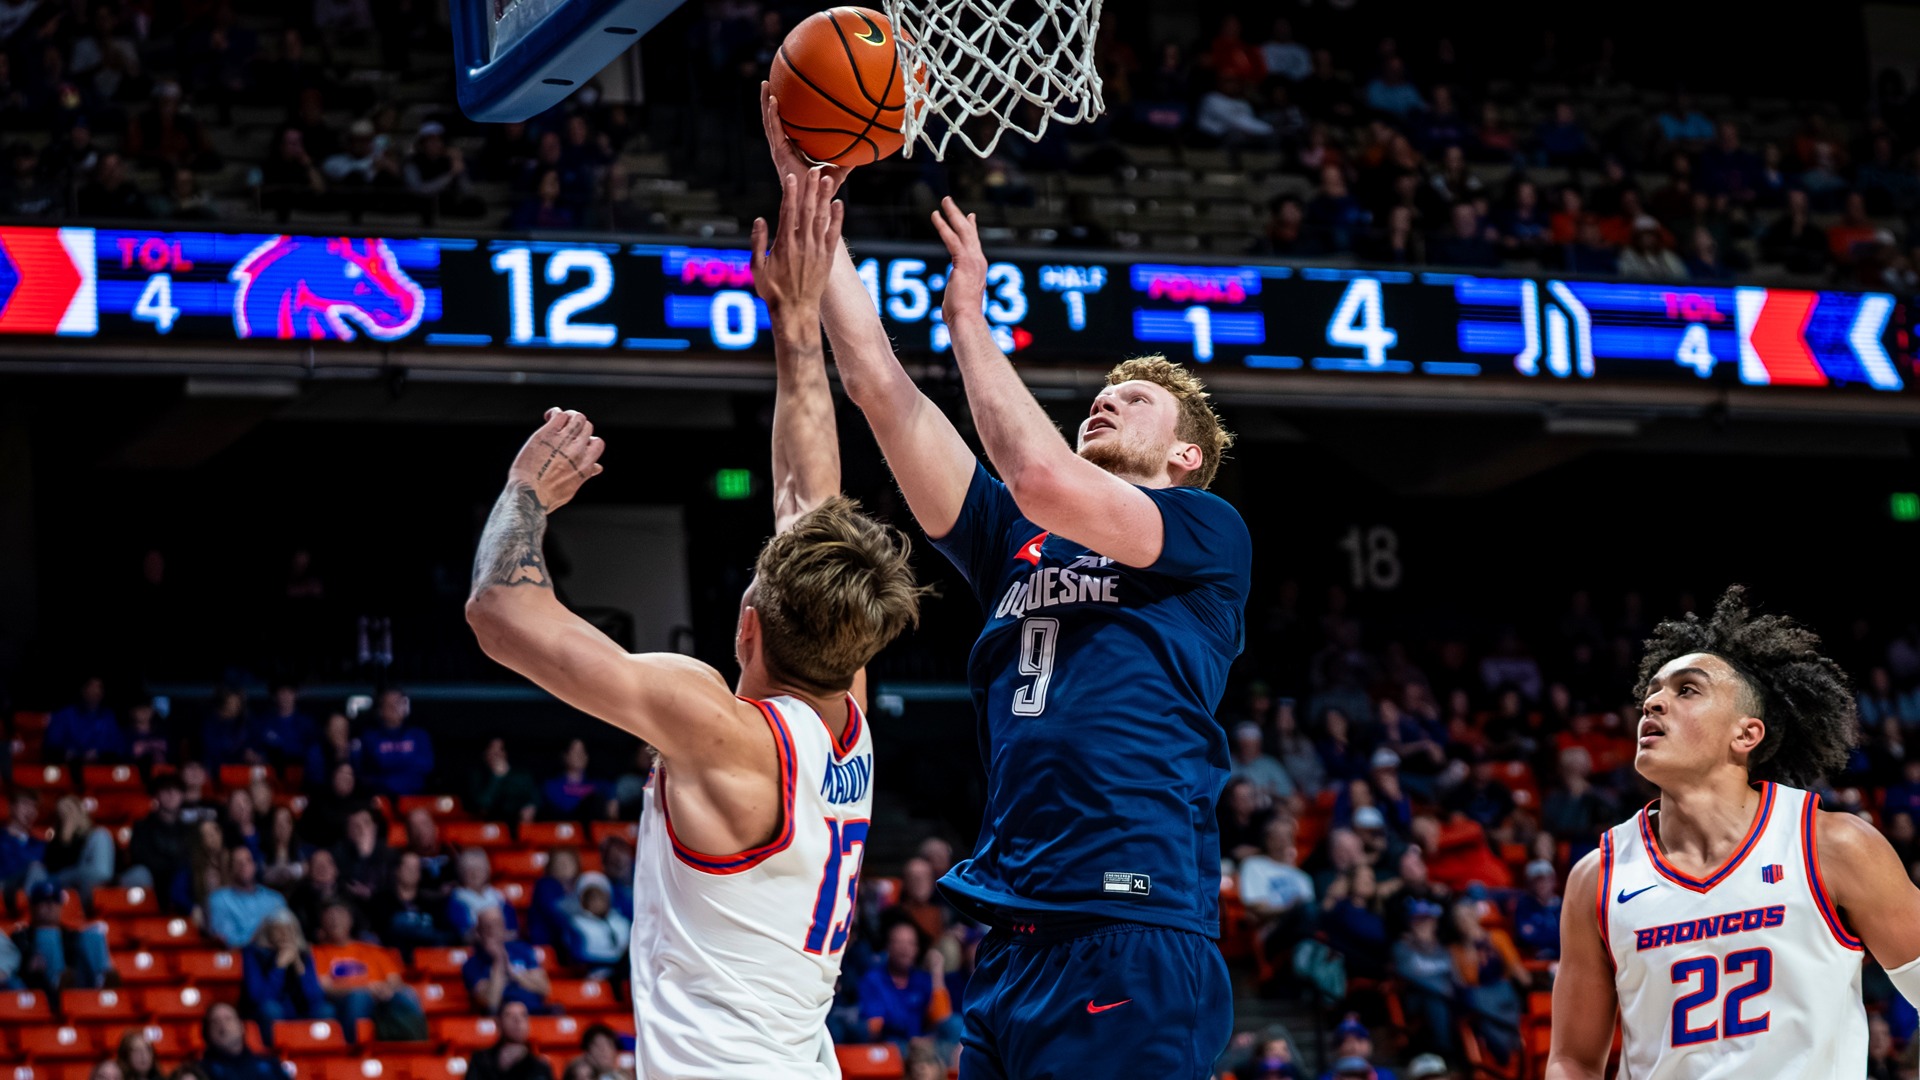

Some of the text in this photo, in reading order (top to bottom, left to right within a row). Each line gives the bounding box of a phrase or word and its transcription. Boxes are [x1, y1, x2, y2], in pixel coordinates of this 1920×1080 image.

[116, 237, 194, 272] TOL
[131, 273, 181, 334] 4
[491, 248, 618, 346] 12
[709, 290, 757, 349] 0
[857, 258, 1028, 324] 15:3
[1062, 290, 1087, 331] 1
[1660, 291, 1726, 323] TOL
[1184, 306, 1214, 363] 1
[1326, 277, 1398, 367] 4
[1675, 322, 1718, 379] 4
[1336, 524, 1403, 591] 18
[1011, 616, 1060, 717] 9
[820, 751, 872, 805] MADDY
[803, 816, 871, 956] 13
[1133, 878, 1147, 890] XL
[1633, 904, 1786, 953] BRONCOS
[1670, 946, 1773, 1048] 22
